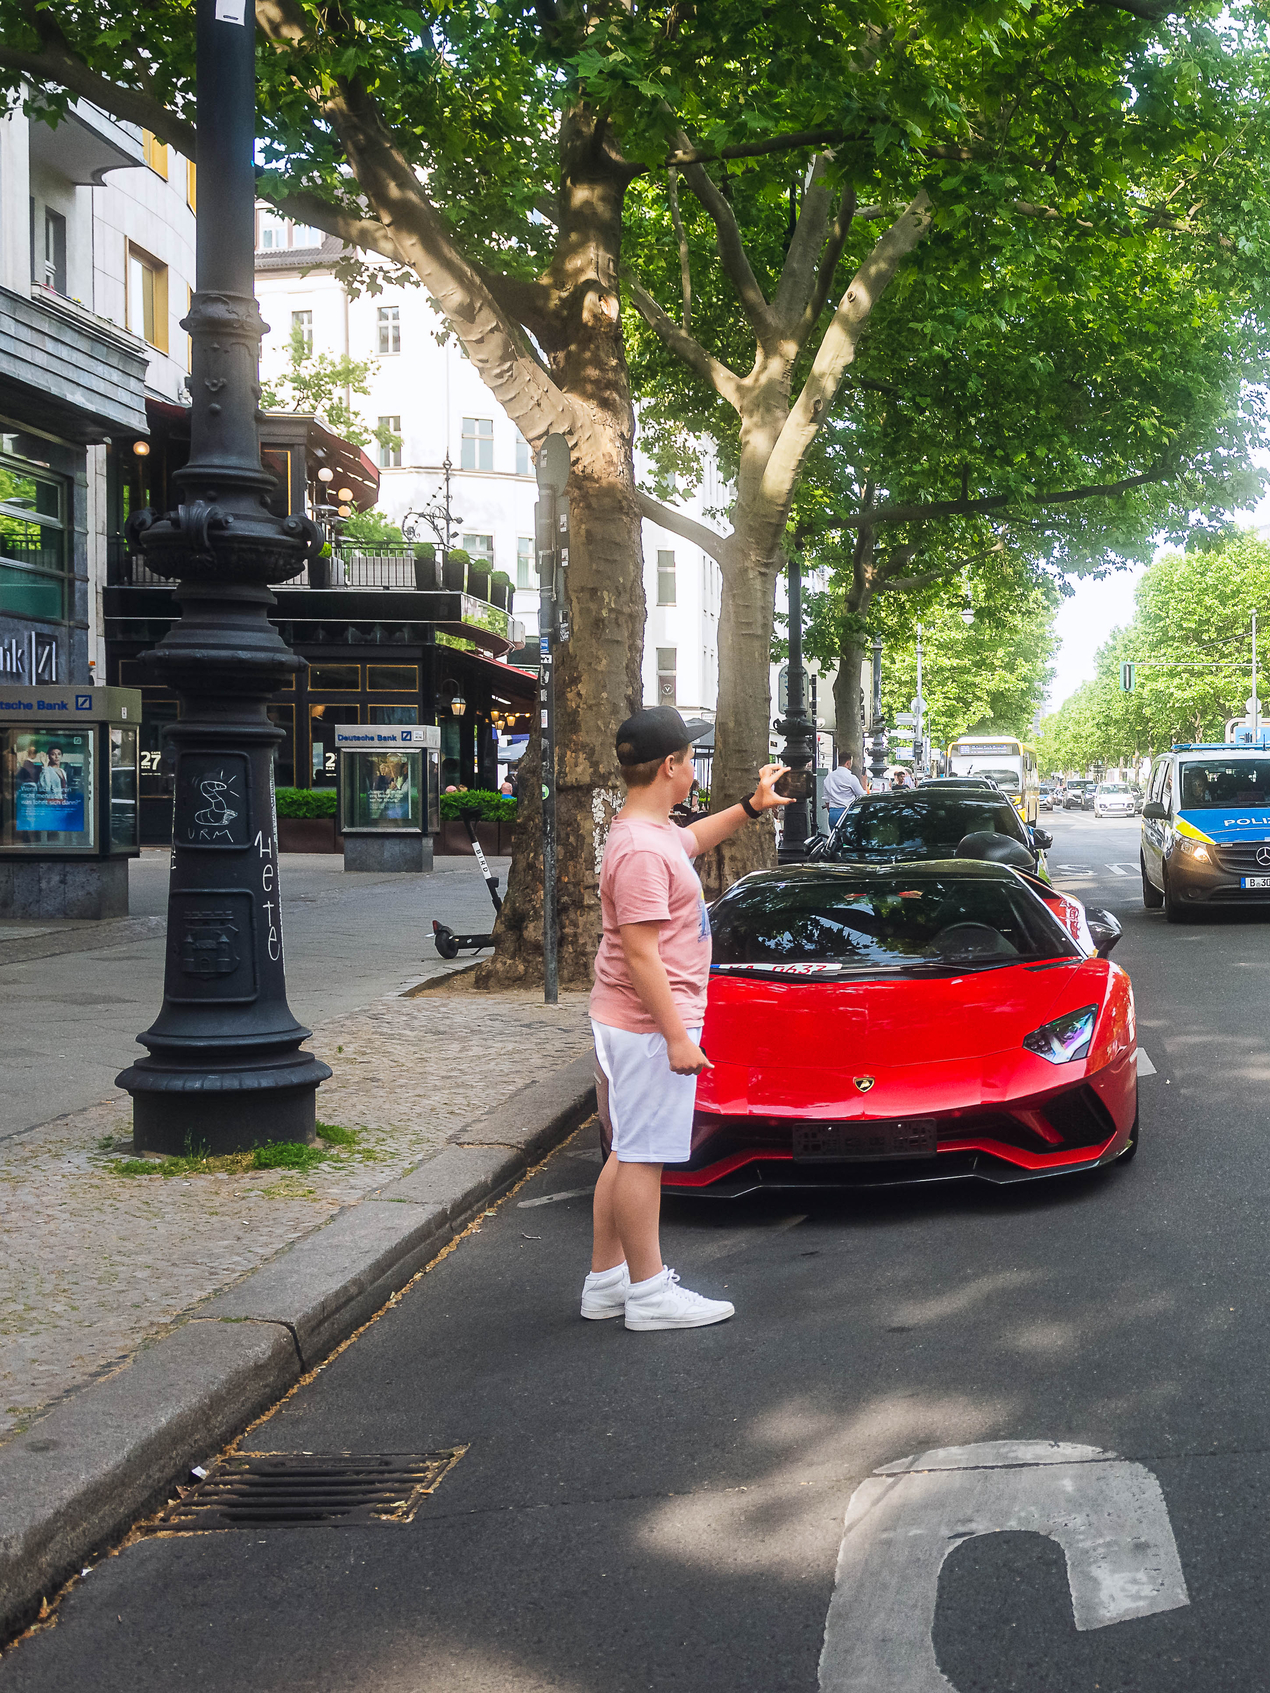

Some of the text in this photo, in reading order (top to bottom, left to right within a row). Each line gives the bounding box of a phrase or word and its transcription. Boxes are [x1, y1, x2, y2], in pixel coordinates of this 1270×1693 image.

[37, 700, 68, 711] Bank
[337, 734, 397, 742] Deutsche Bank
[141, 751, 161, 770] 27
[476, 849, 489, 872] BIRD
[1249, 878, 1256, 887] B
